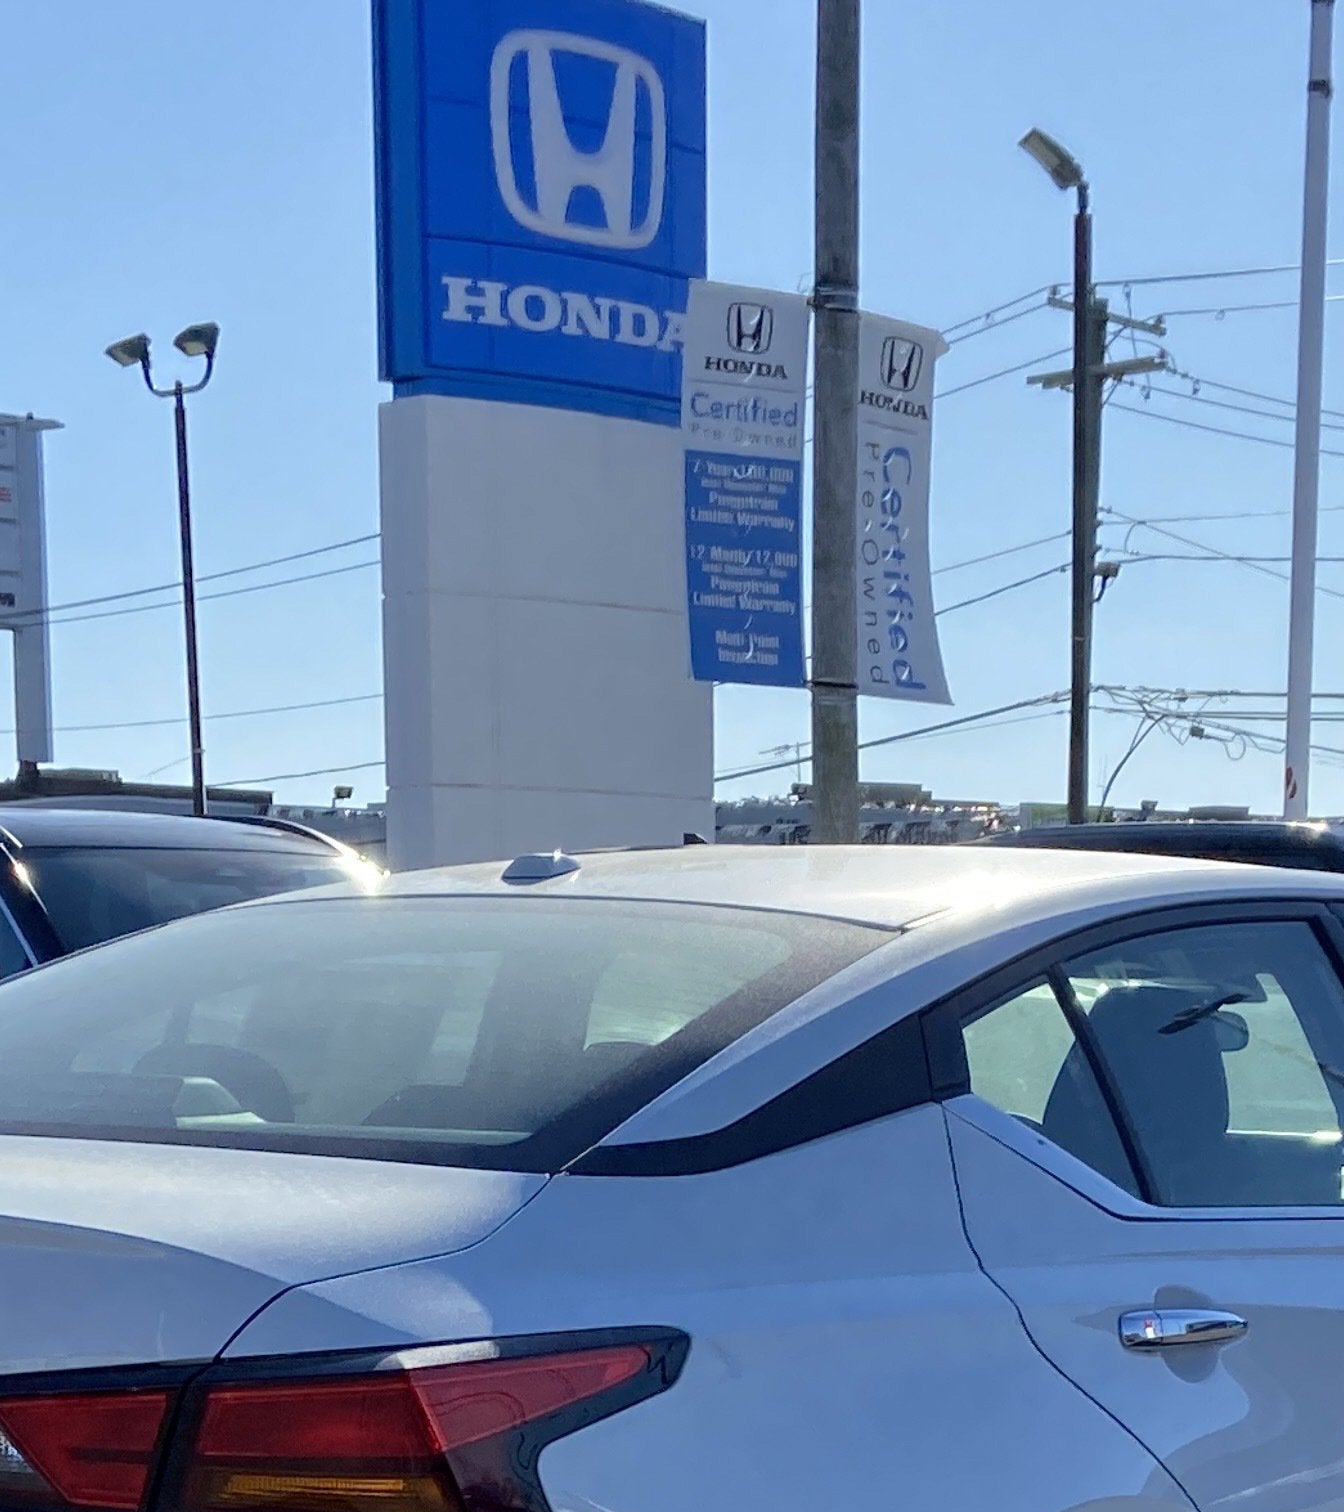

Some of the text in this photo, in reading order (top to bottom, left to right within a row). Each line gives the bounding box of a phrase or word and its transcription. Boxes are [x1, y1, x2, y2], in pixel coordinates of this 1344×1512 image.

[441, 276, 688, 351] HONDA
[704, 356, 787, 379] HONDA
[690, 391, 798, 427] Certified
[860, 390, 928, 420] HONDA
[861, 442, 889, 684] Pre-Owned
[880, 446, 926, 690] Certified
